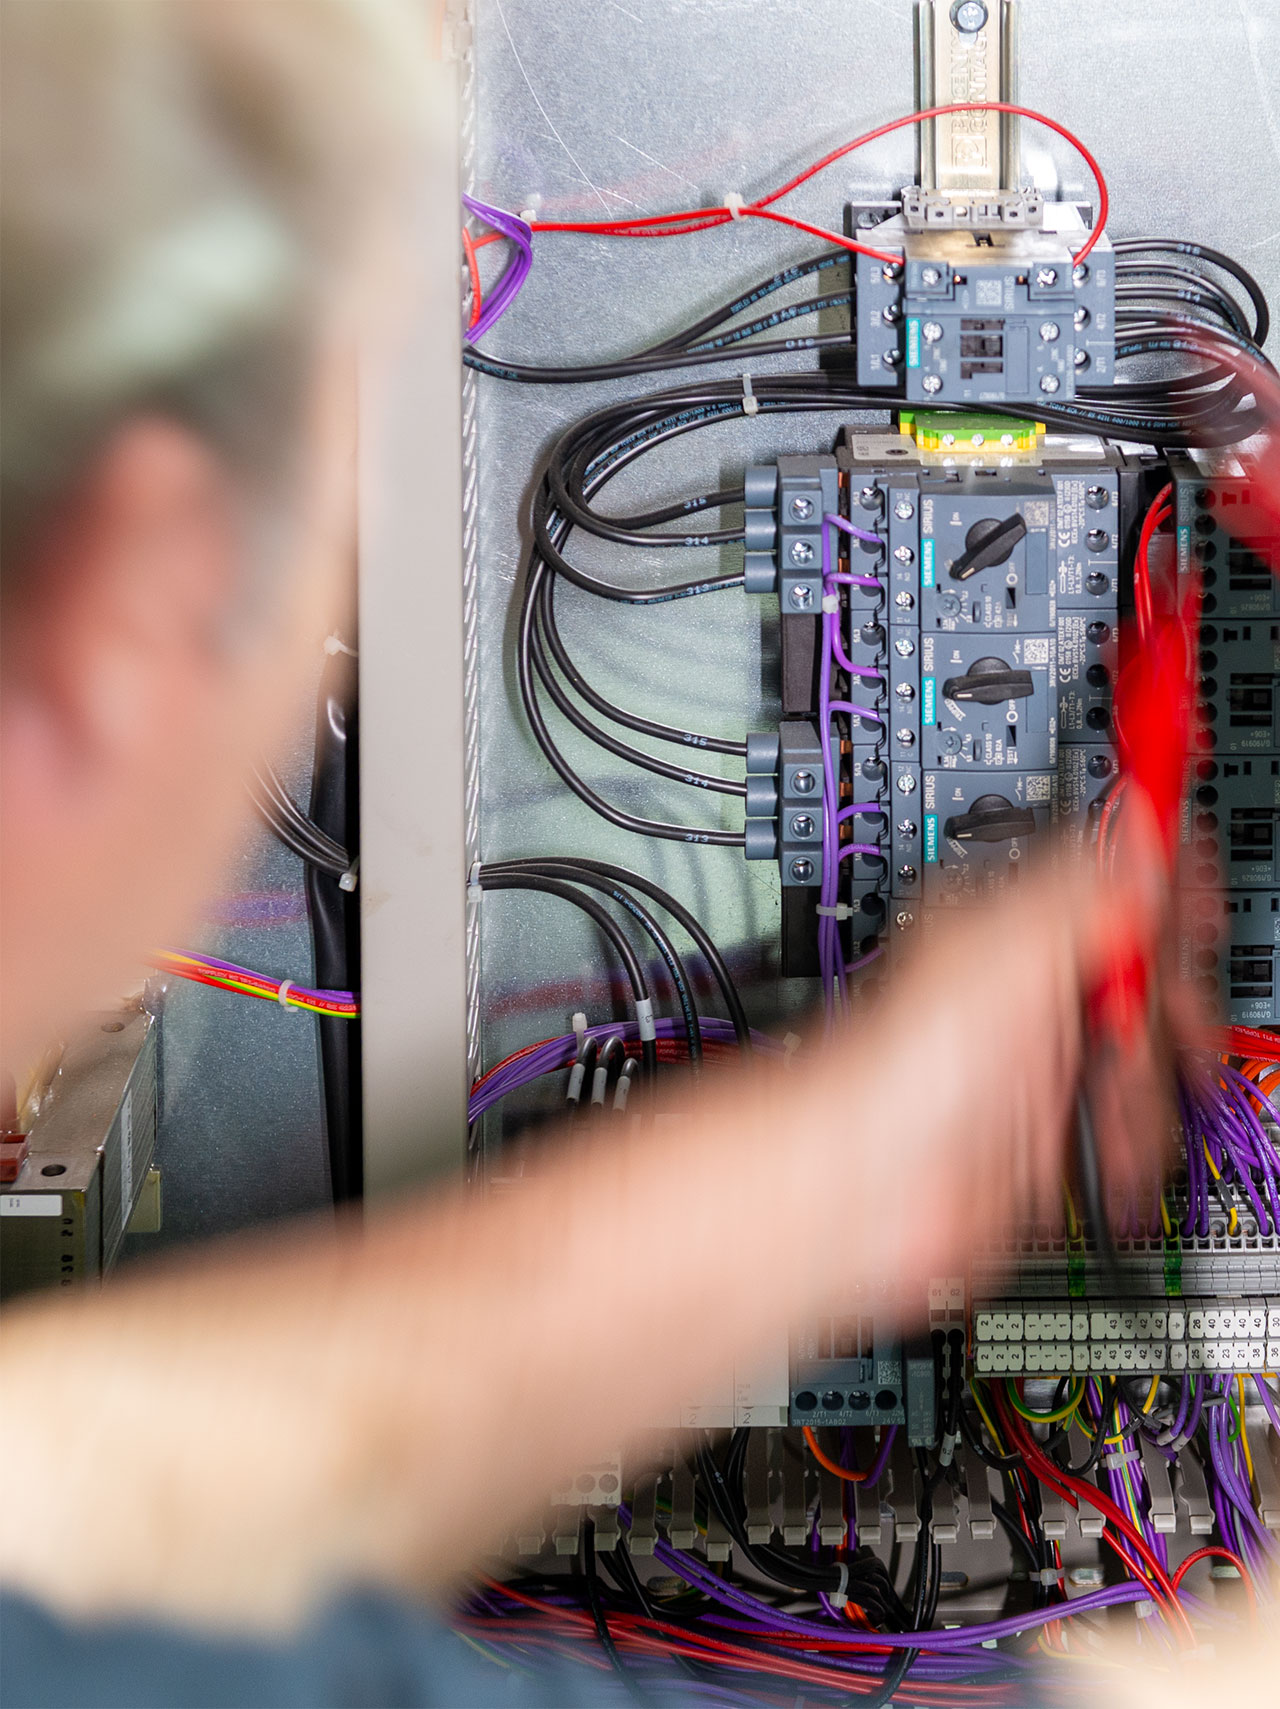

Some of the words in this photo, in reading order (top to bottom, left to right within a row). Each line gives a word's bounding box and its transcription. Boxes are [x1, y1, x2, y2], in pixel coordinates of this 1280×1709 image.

[1005, 276, 1014, 310] SIRIUS
[909, 321, 918, 366] SIEMENS
[684, 497, 707, 509] 315
[1180, 488, 1189, 521] SIRIUS
[924, 499, 933, 533] SIRIUS
[685, 537, 709, 545] 314
[924, 541, 932, 585] SIEMENS
[687, 584, 709, 595] 313
[924, 638, 933, 671] SIRIUS
[952, 650, 960, 659] ON
[925, 680, 933, 723] SIEMENS
[685, 774, 709, 787] 314
[926, 775, 935, 808] SIRIUS
[955, 788, 962, 797] ON
[685, 834, 709, 842] 313
[927, 817, 935, 861] SIEMENS
[1110, 1320, 1117, 1329] 43
[1125, 1320, 1132, 1329] 43
[1141, 1319, 1147, 1329] 42
[1155, 1319, 1162, 1329] 42
[1193, 1319, 1201, 1329] 26
[1208, 1319, 1216, 1329] 40
[1224, 1319, 1231, 1328] 40
[1239, 1318, 1246, 1328] 40
[1254, 1318, 1261, 1328] 40
[1273, 1317, 1280, 1327] 30
[1094, 1350, 1102, 1360] 45
[1109, 1350, 1116, 1359] 43
[1125, 1350, 1132, 1359] 43
[1140, 1349, 1147, 1359] 42
[1155, 1349, 1162, 1359] 42
[1192, 1349, 1199, 1359] 25
[1207, 1349, 1214, 1359] 24
[1222, 1349, 1230, 1358] 23
[1238, 1349, 1245, 1358] 21
[1253, 1348, 1260, 1358] 38
[1271, 1348, 1279, 1357] 36
[743, 1413, 751, 1424] 2
